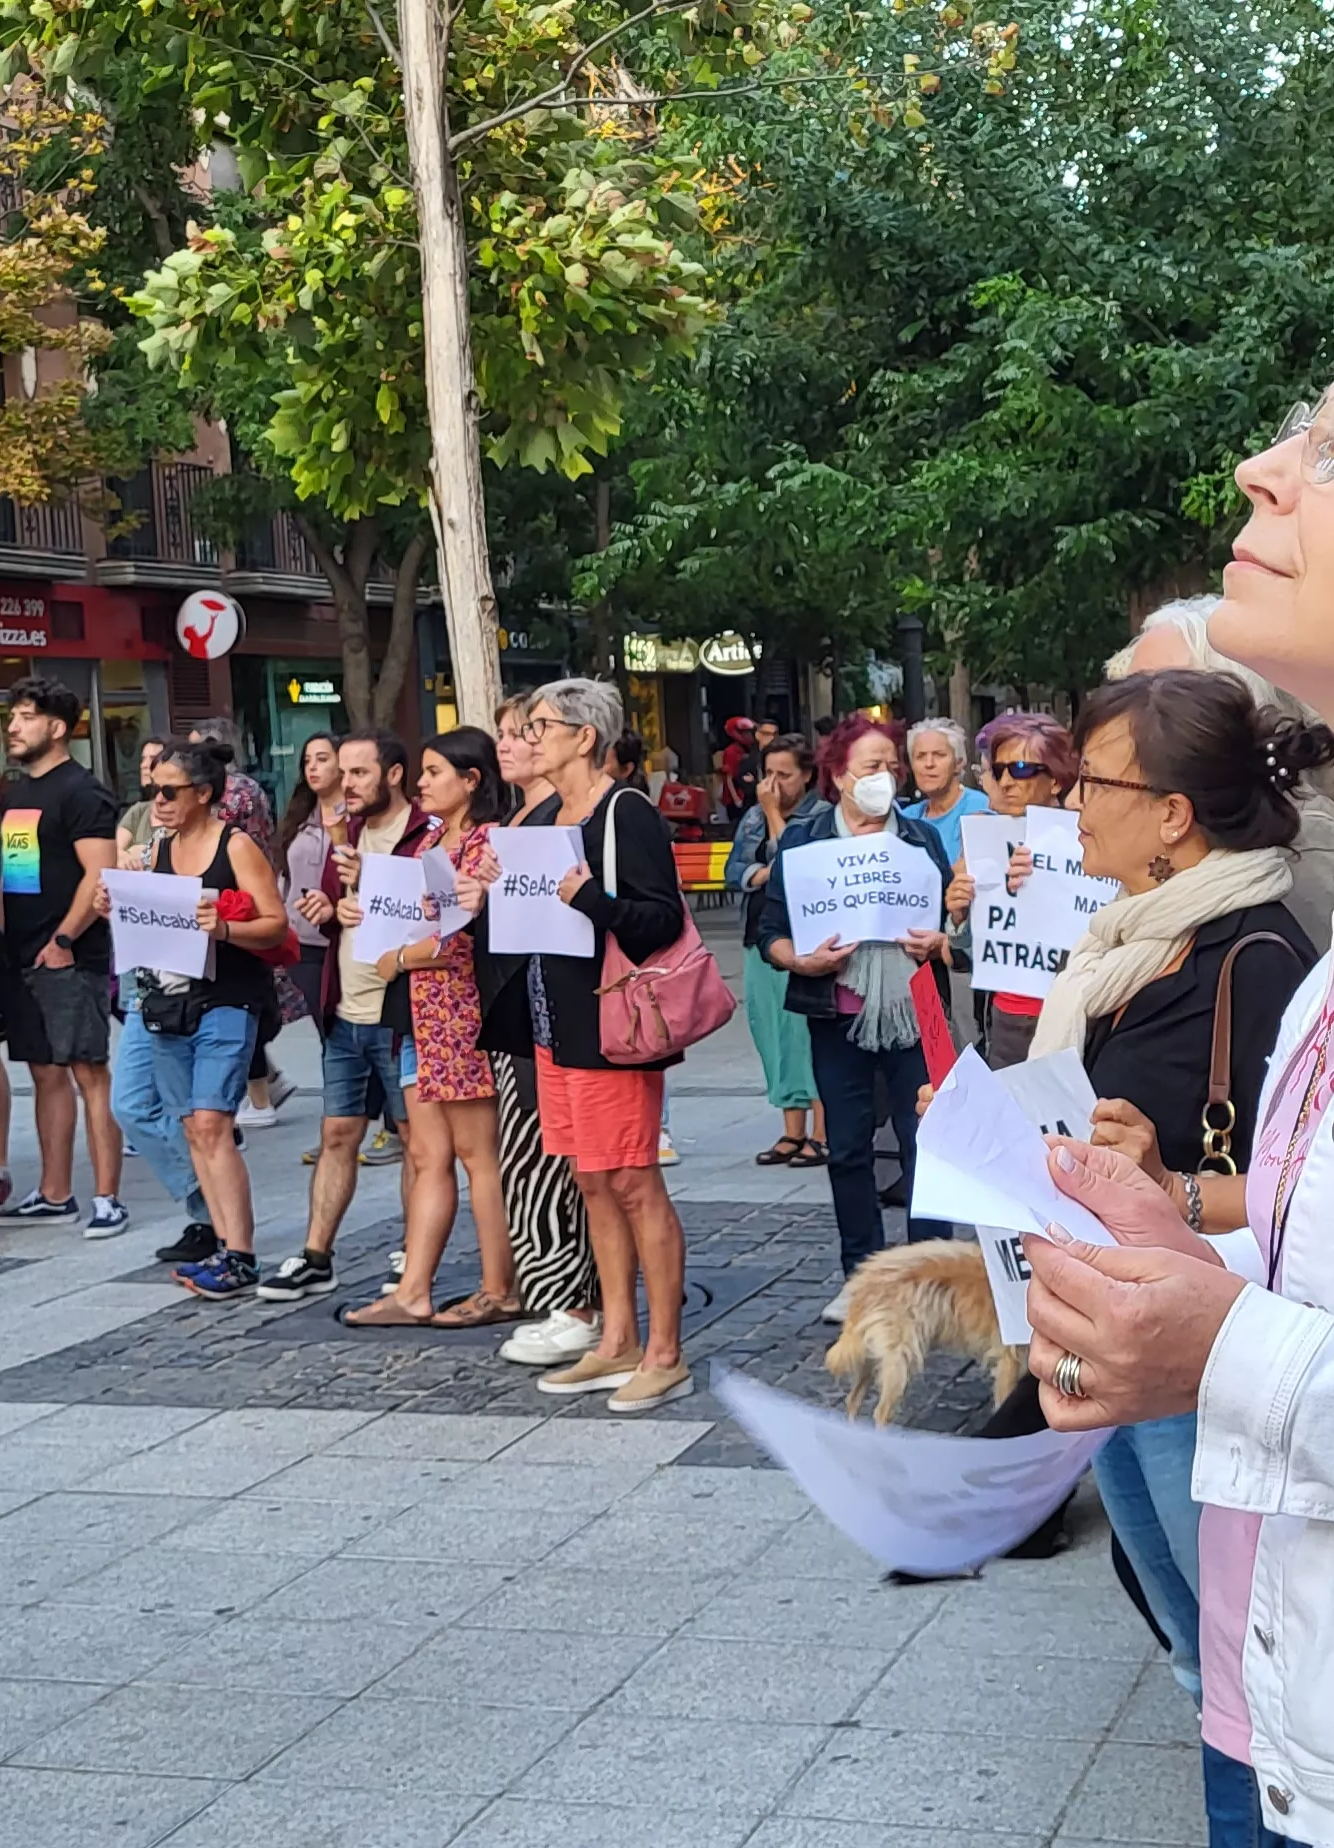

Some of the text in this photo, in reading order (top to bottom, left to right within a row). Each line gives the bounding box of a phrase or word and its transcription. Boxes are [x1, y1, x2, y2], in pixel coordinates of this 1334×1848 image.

[0, 596, 22, 616] 226
[836, 850, 890, 869] VIVAS
[1033, 852, 1058, 873] EL
[826, 870, 902, 890] Y LIBRES
[369, 895, 423, 922] #SeAcab
[802, 890, 930, 918] NOS QUEREMOS
[987, 905, 1017, 931] PA
